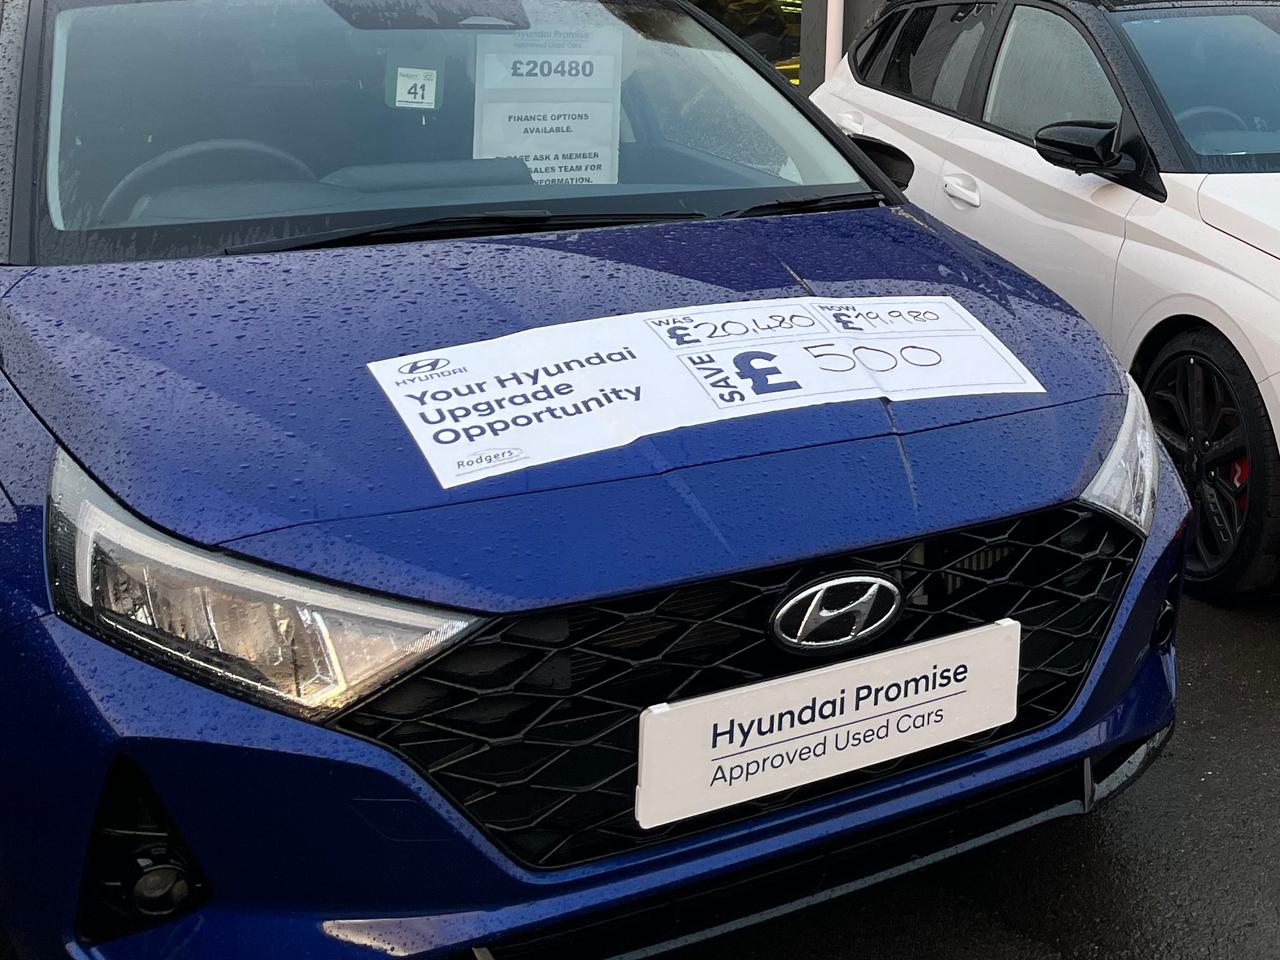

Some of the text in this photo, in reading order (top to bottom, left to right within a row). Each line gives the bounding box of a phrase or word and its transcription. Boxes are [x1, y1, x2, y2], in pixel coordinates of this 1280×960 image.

[511, 60, 594, 77] £20480
[407, 83, 426, 100] 41
[508, 113, 589, 122] FINANCE OPTIONS
[523, 126, 574, 134] AVAILABLE.
[532, 154, 551, 162] ASK
[553, 153, 560, 161] A
[562, 152, 600, 160] MEMBER
[558, 164, 583, 172] TEAM
[585, 164, 602, 172] FOR
[817, 304, 857, 312] NOW
[651, 316, 695, 327] WAS
[395, 366, 468, 387] HYUNDAI
[405, 346, 638, 406] Your Hyundai
[688, 353, 746, 403] SAVE
[419, 382, 576, 425] Upgrade
[432, 386, 642, 445] Opportunity
[456, 448, 514, 469] Rodgers
[711, 663, 968, 749] Hyundai Promise
[710, 707, 944, 787] Approved Used Cars
